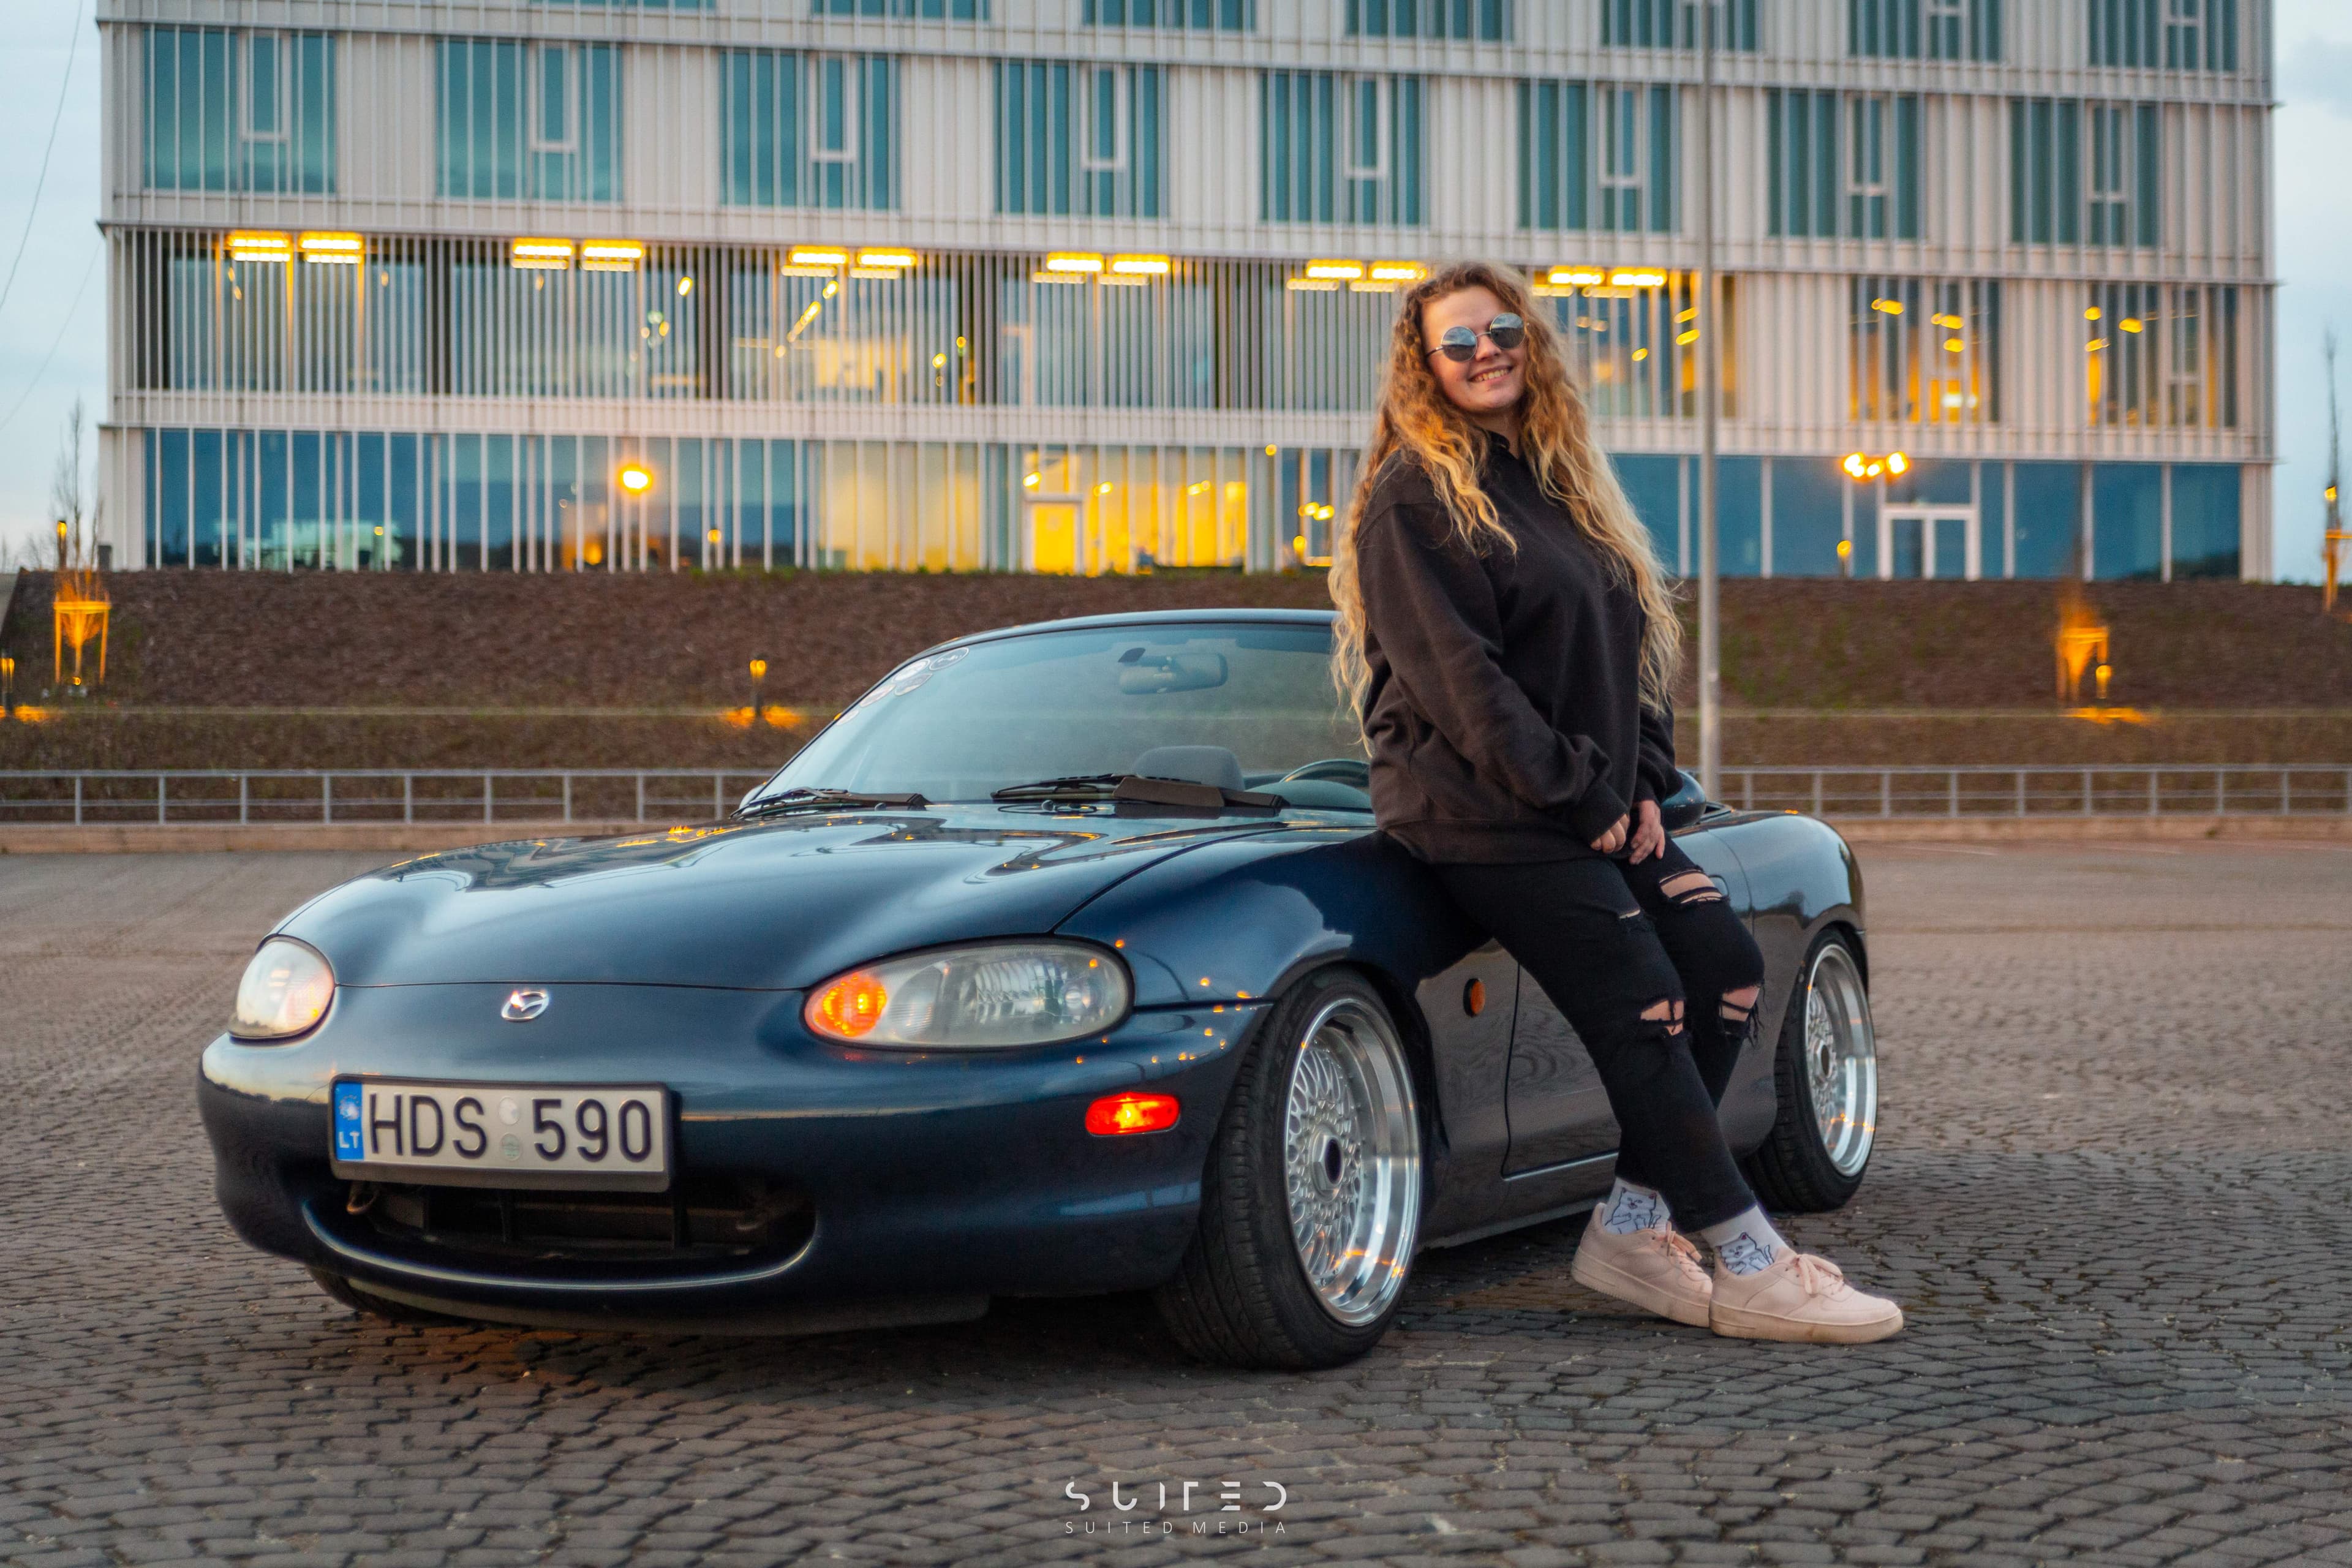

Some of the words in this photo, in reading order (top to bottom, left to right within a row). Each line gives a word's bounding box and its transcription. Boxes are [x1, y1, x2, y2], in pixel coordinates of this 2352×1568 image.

[339, 1131, 360, 1149] LT
[369, 1093, 488, 1159] HDS
[532, 1098, 652, 1162] 590
